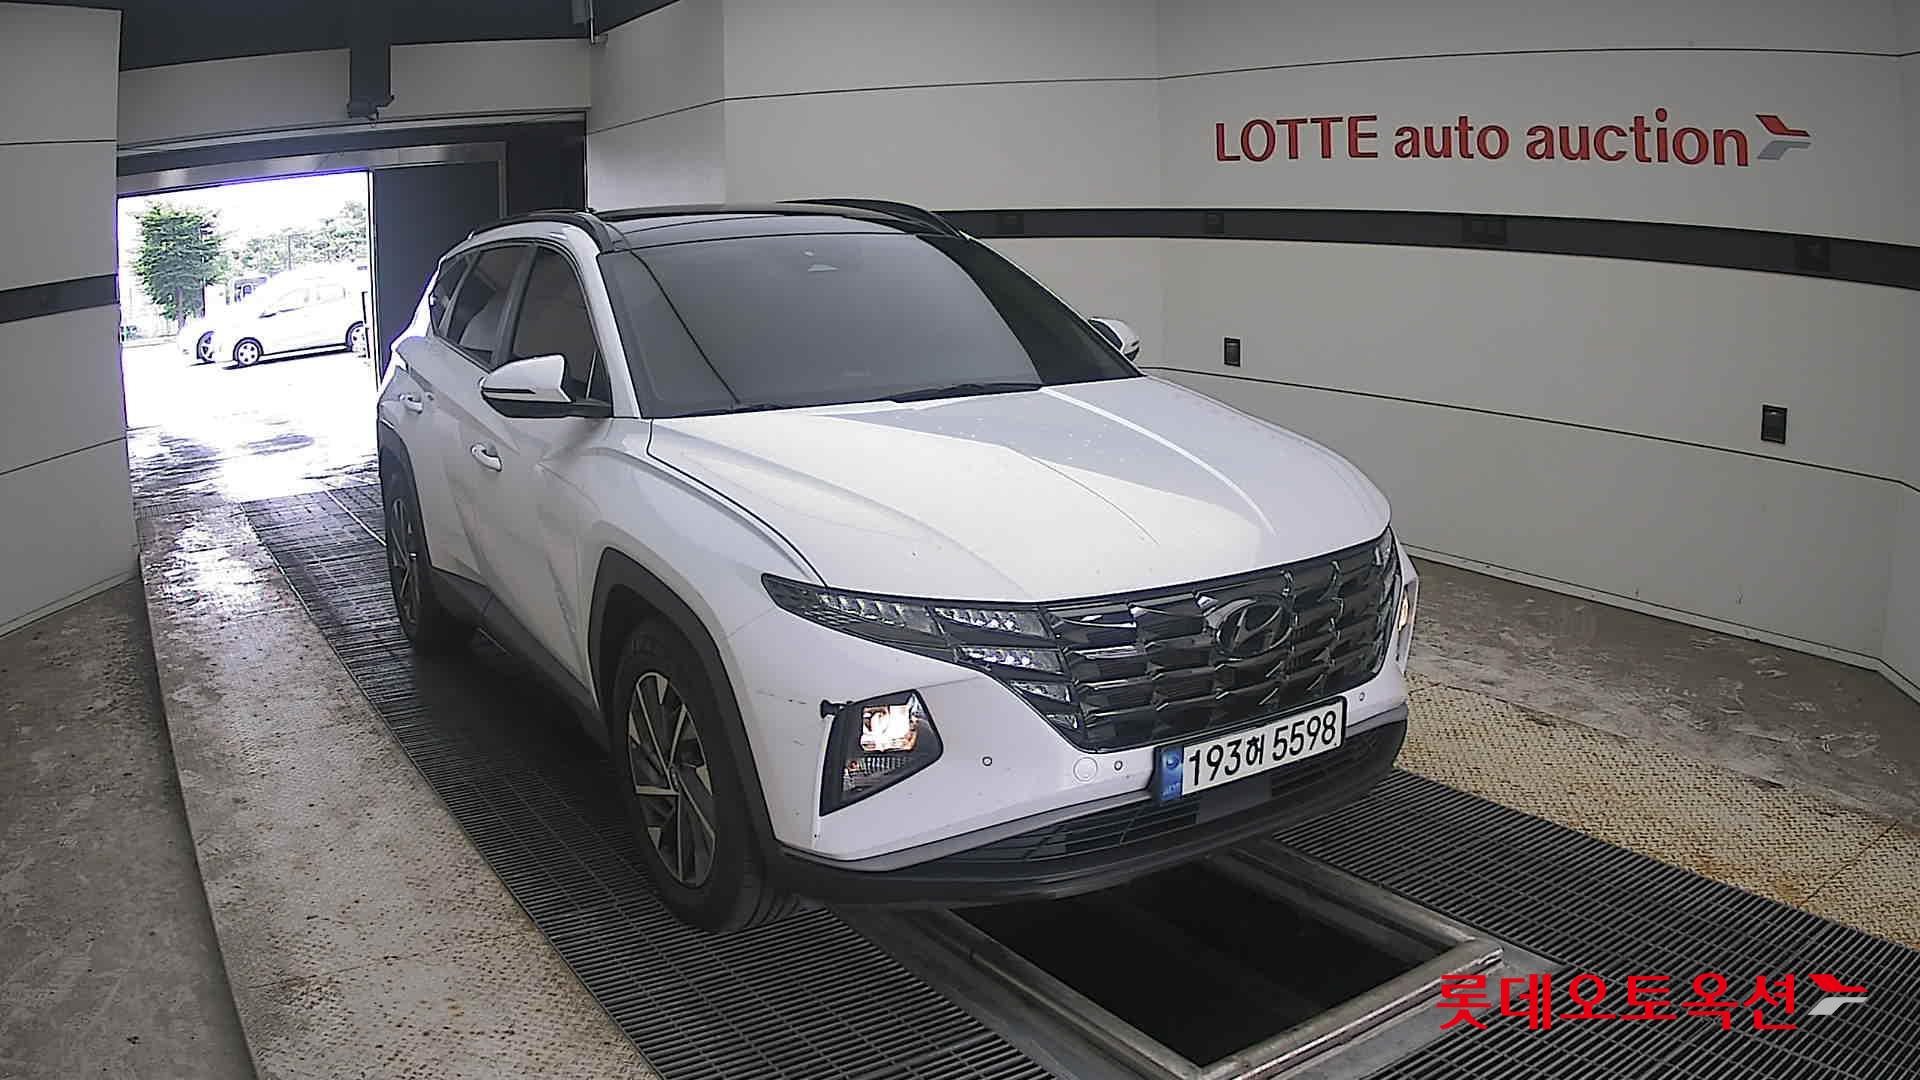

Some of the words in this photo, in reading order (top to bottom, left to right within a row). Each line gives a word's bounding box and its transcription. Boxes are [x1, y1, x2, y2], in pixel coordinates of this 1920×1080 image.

[1215, 115, 1379, 162] LOTTE
[1393, 116, 1510, 160] auto
[1525, 107, 1749, 167] auction
[1188, 733, 1265, 786] 193허
[1272, 710, 1337, 762] 5598
